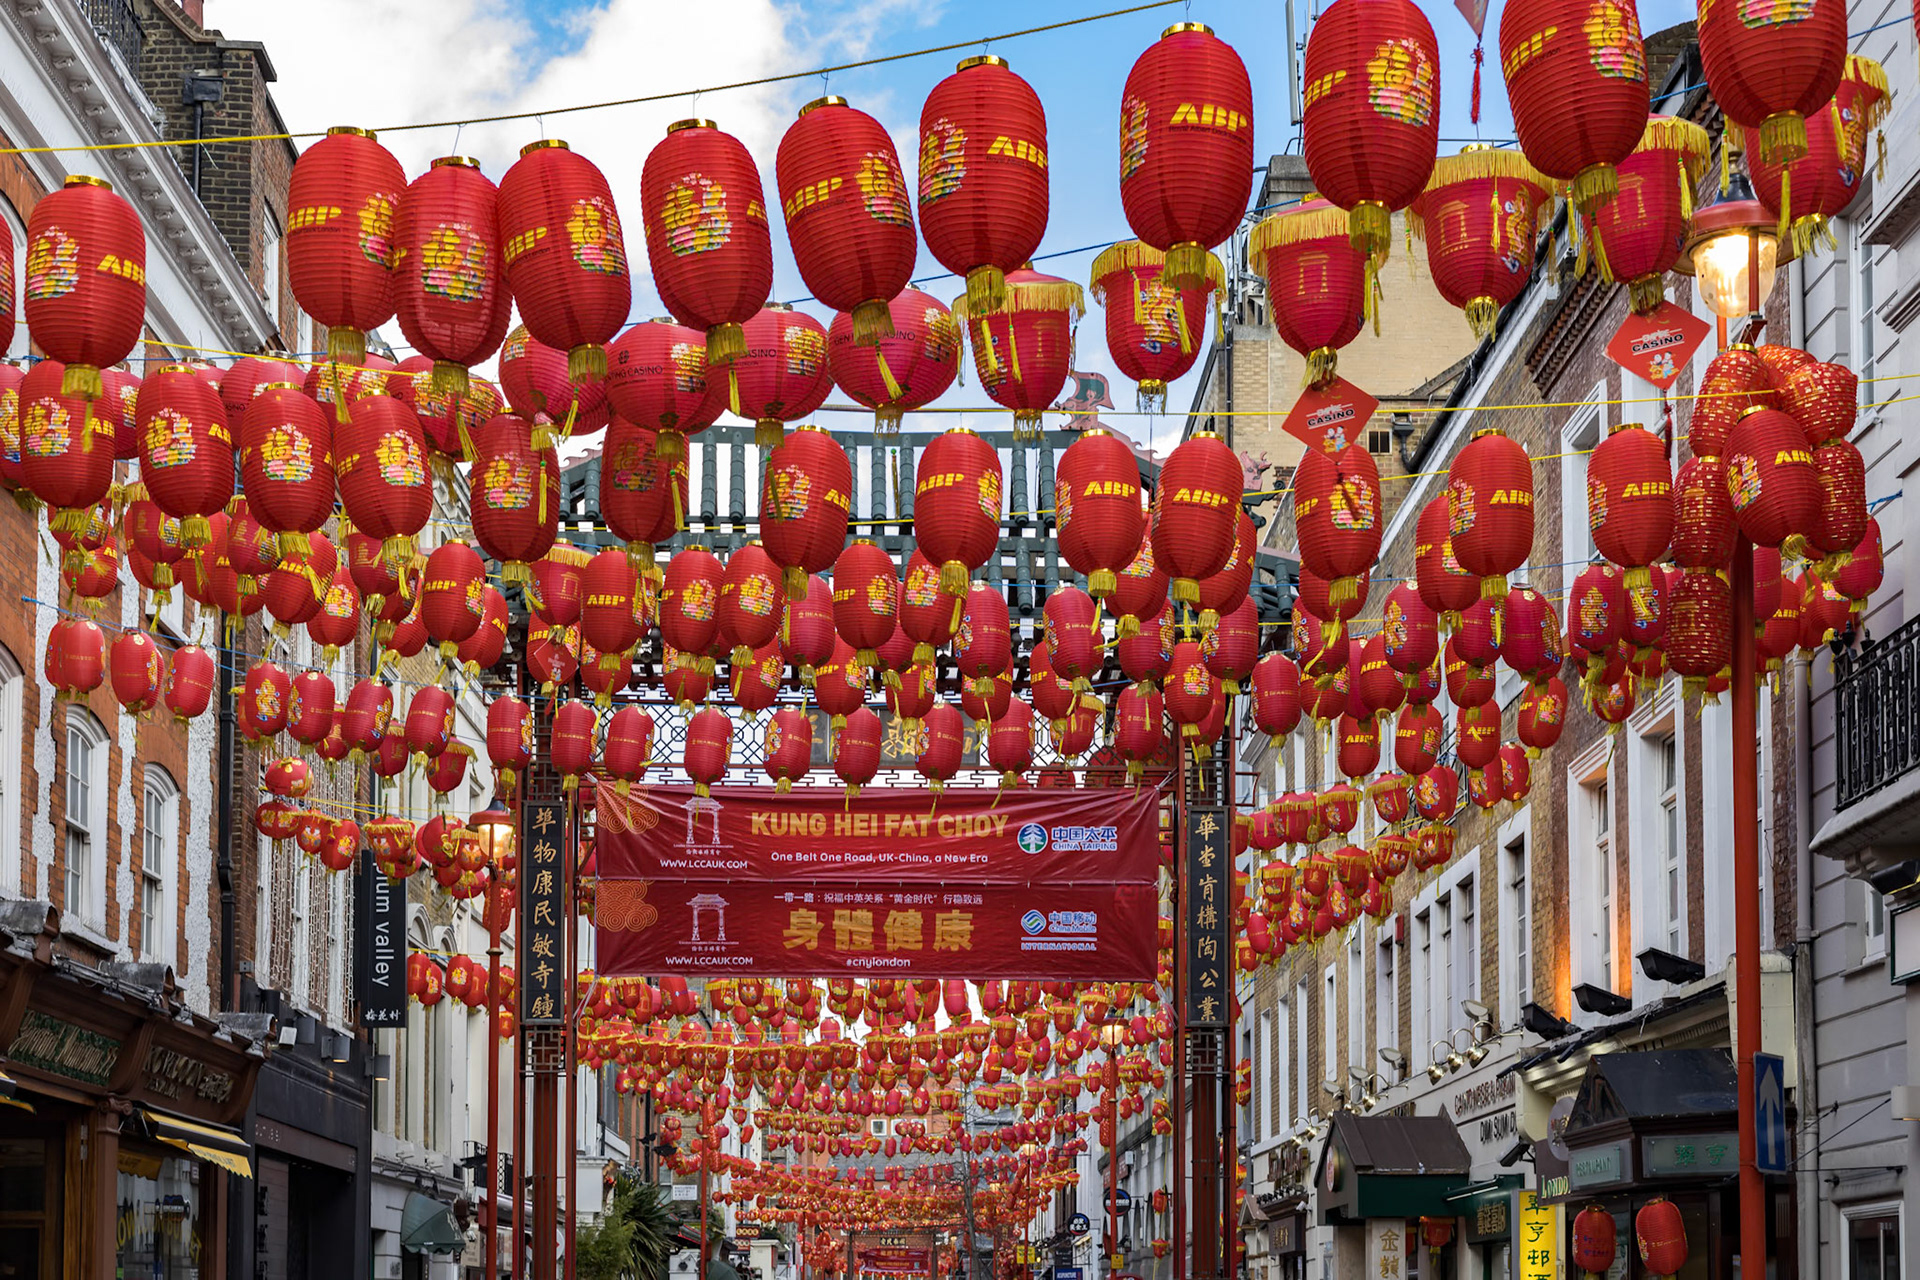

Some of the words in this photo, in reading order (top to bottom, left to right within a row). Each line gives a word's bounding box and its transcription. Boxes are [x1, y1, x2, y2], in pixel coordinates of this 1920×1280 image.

[1169, 102, 1248, 131] ABP
[1632, 334, 1684, 352] CASINO
[627, 365, 663, 377] CASINO
[1307, 409, 1355, 426] CASINO
[917, 473, 964, 496] ABP
[1083, 481, 1136, 498] ABP
[1621, 482, 1670, 498] ABP
[1172, 488, 1229, 507] ABP
[424, 580, 457, 592] ABP
[587, 594, 625, 606] ABP
[1773, 608, 1799, 618] ABP
[751, 812, 826, 836] KUNG
[834, 813, 878, 836] HEI
[884, 813, 929, 837] FAT
[937, 814, 1009, 838] CHOY
[1052, 827, 1117, 841] 中国太平
[1052, 842, 1079, 850] CHINA
[1082, 842, 1117, 850] TAIPING
[660, 859, 748, 869] WWW.LCCAUK.COM
[771, 851, 793, 861] One
[796, 852, 817, 862] Belt
[820, 852, 841, 862] One
[844, 852, 876, 864] Road,
[879, 853, 933, 864] UK-China,
[946, 853, 967, 863] New
[969, 853, 988, 863] Era
[1049, 911, 1097, 924] 中国移动
[782, 908, 974, 951] 身體健康
[1049, 925, 1070, 933] China
[1072, 925, 1097, 933] Mobile
[372, 921, 394, 987] valley
[1021, 943, 1097, 951] INTERNATIONAL
[665, 956, 753, 965] WWW.LCCAUK.COM
[846, 957, 911, 969] #cnylondon
[1541, 1175, 1571, 1199] LONDO
[1525, 1194, 1551, 1280] 翠亨邨
